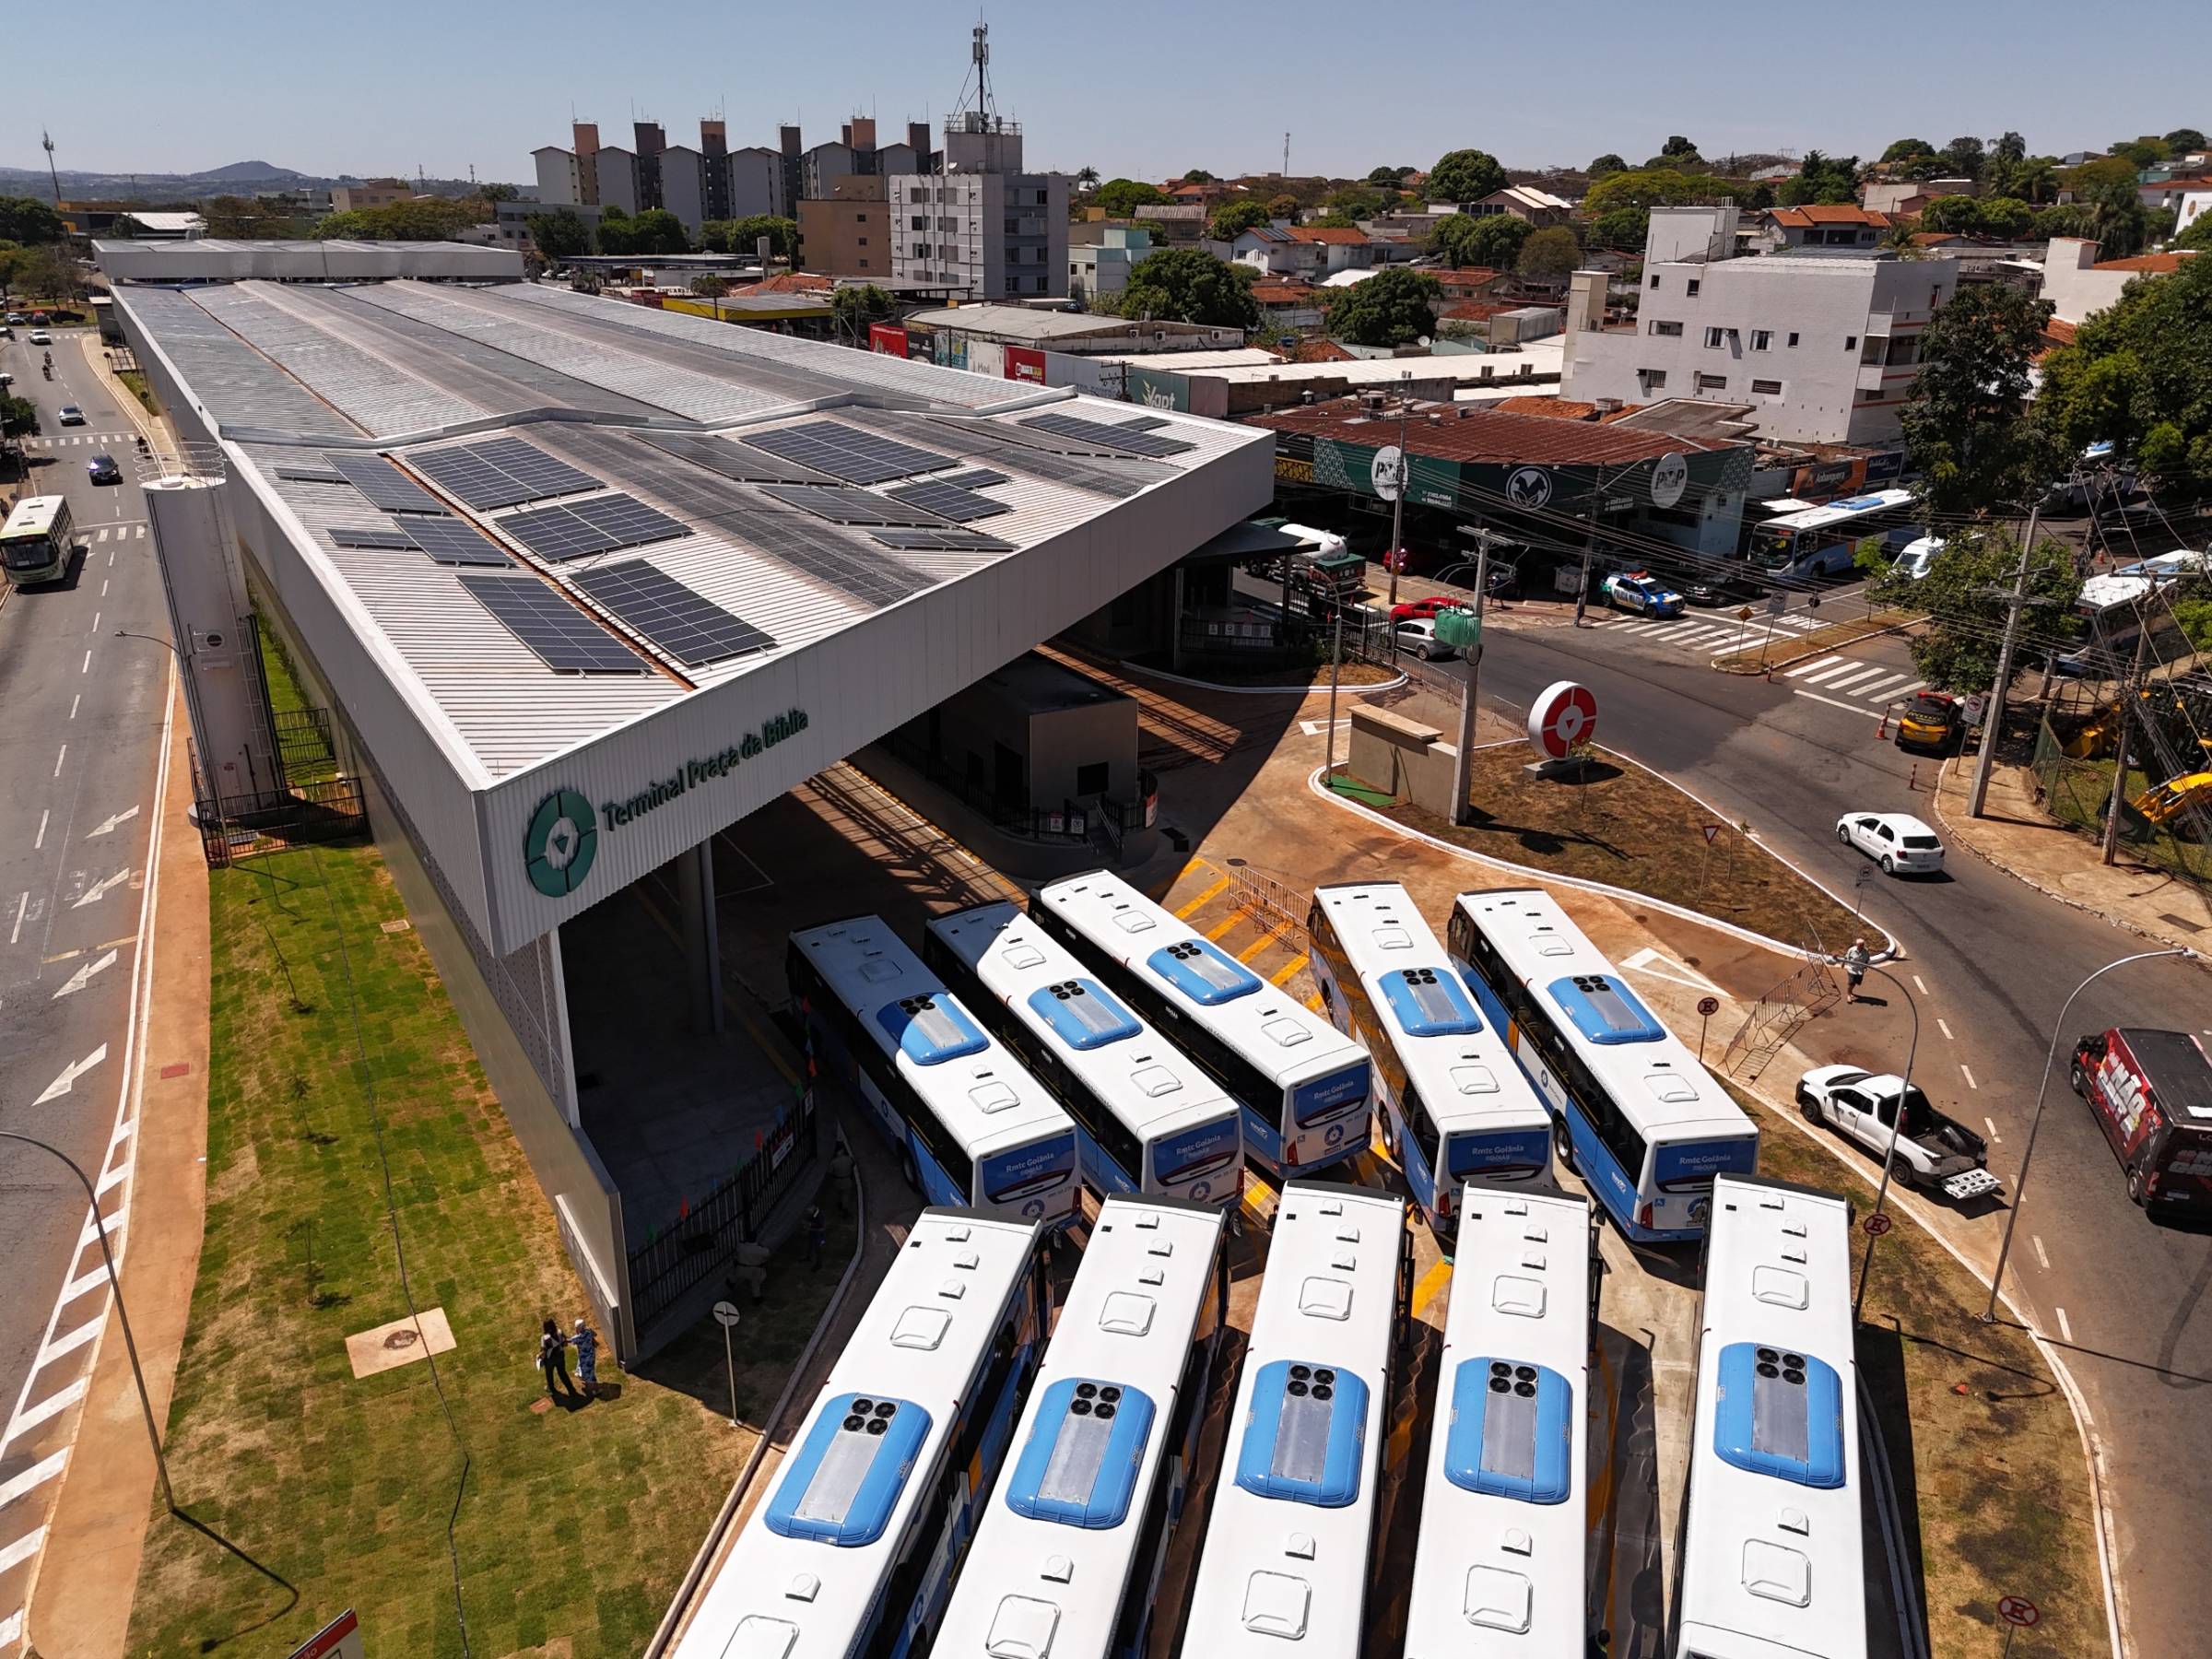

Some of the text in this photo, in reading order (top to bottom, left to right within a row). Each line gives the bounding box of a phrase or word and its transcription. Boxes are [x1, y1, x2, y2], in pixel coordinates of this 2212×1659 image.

[602, 708, 808, 831] Terminal Praça da Bíblia
[1472, 1144, 1524, 1156] Rmtc Goiânia
[1006, 1161, 1026, 1173] Rmtc
[1026, 1153, 1054, 1166] Goiânia
[1679, 1154, 1732, 1165] Rmtc Goiânia
